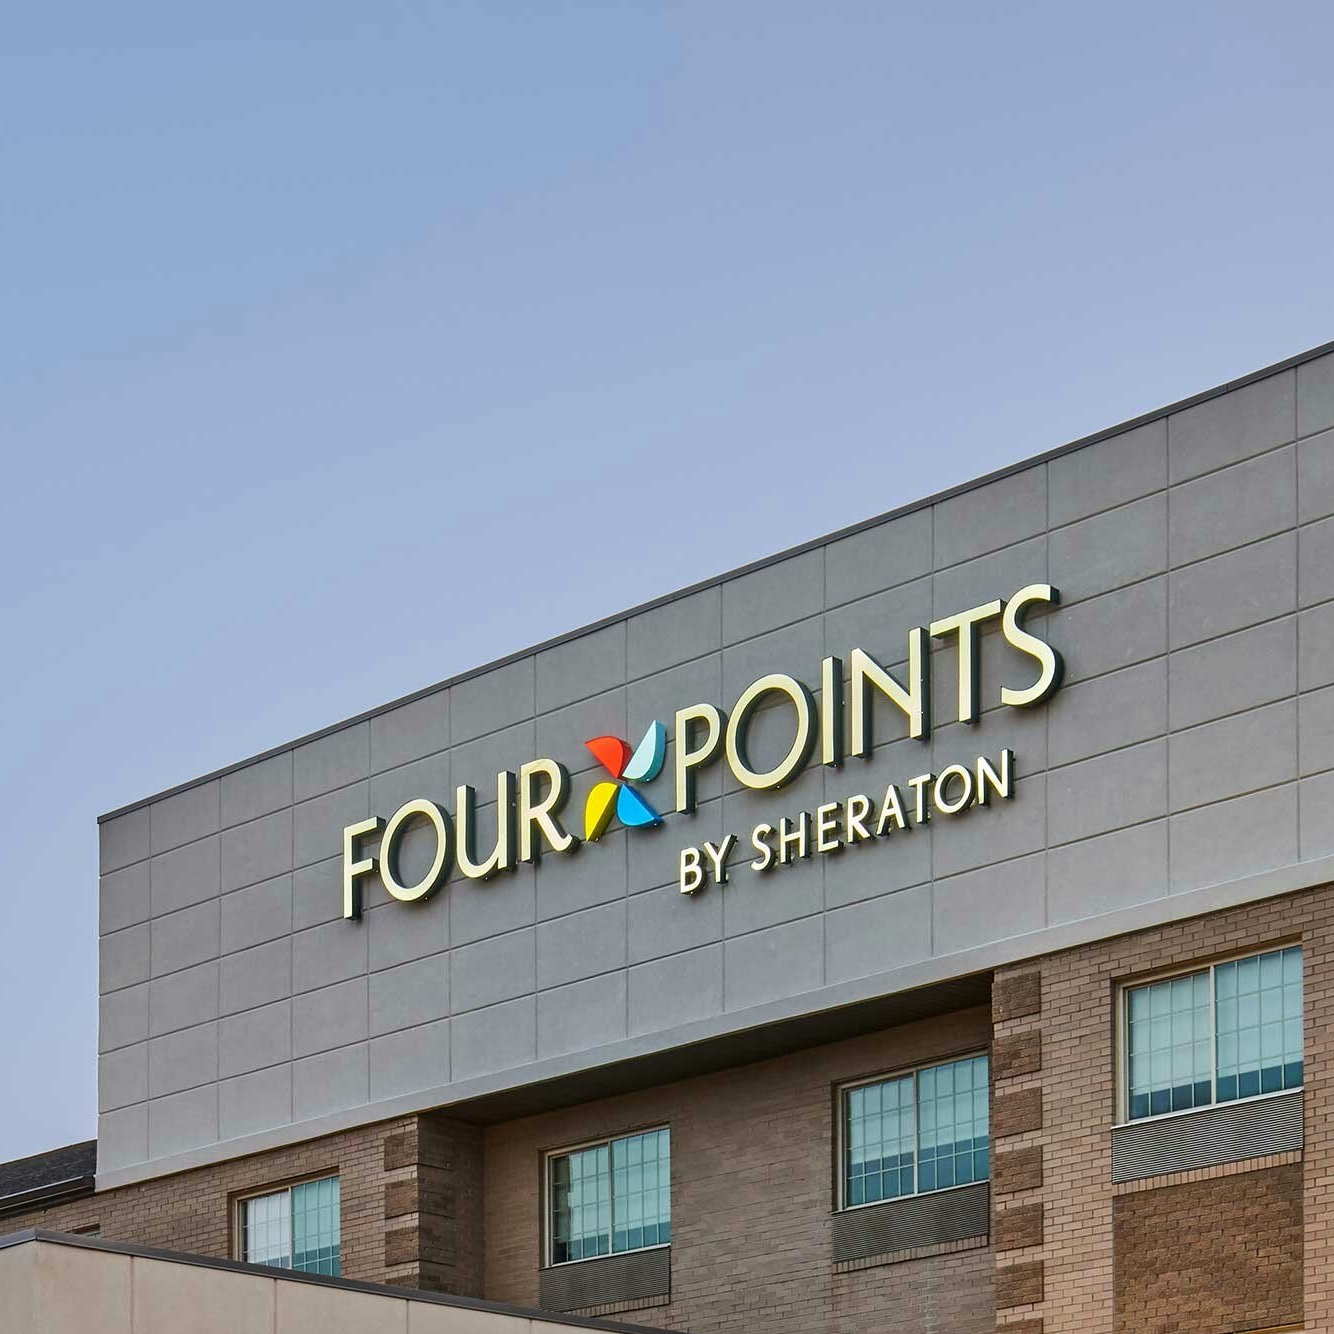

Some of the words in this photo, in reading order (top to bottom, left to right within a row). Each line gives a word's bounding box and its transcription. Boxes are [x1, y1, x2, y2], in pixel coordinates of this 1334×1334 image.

[343, 758, 577, 921] FOUR
[675, 584, 1062, 814] POINTS
[680, 834, 738, 895] BY
[751, 749, 1014, 871] SHERATON
